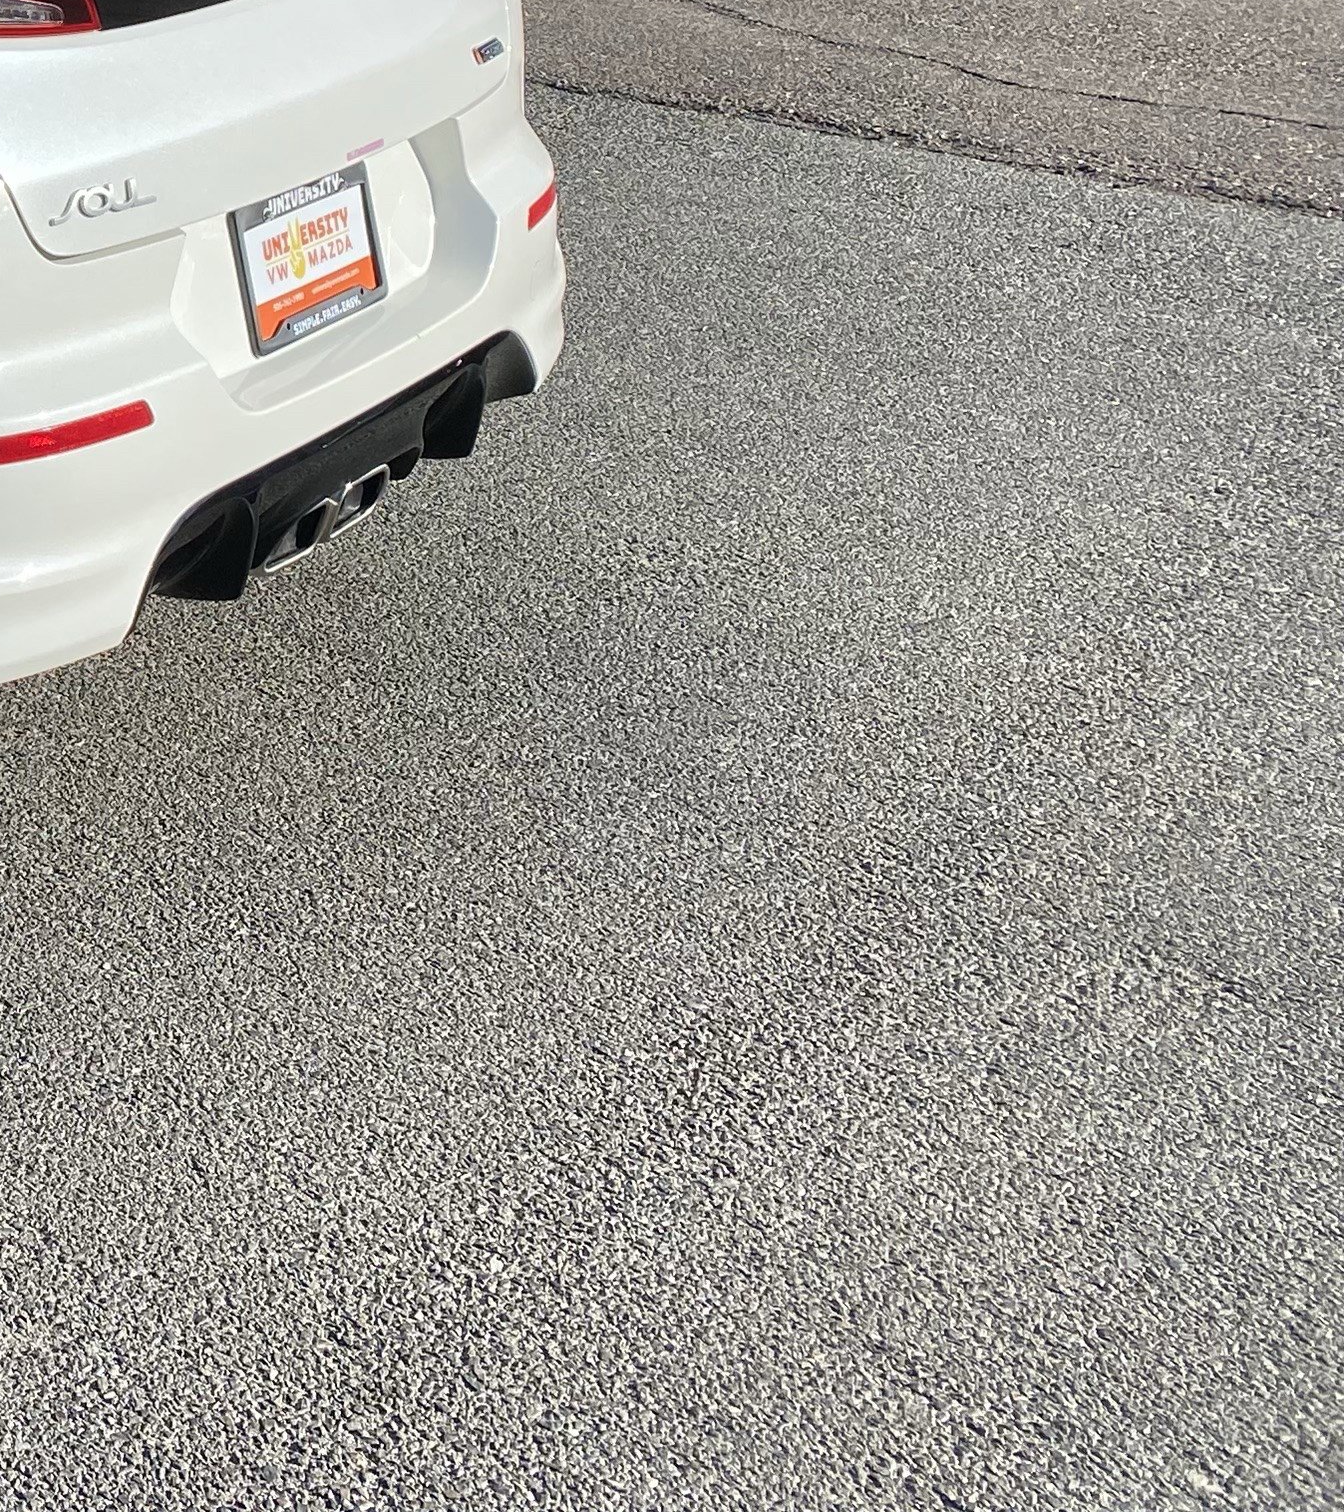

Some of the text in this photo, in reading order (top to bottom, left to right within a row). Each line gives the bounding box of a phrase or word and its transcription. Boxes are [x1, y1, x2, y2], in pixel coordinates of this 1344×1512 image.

[268, 172, 340, 216] UNIVERSITY
[262, 206, 349, 261] UNIVERSITY
[266, 262, 289, 285] VW
[308, 234, 354, 268] MAZDA
